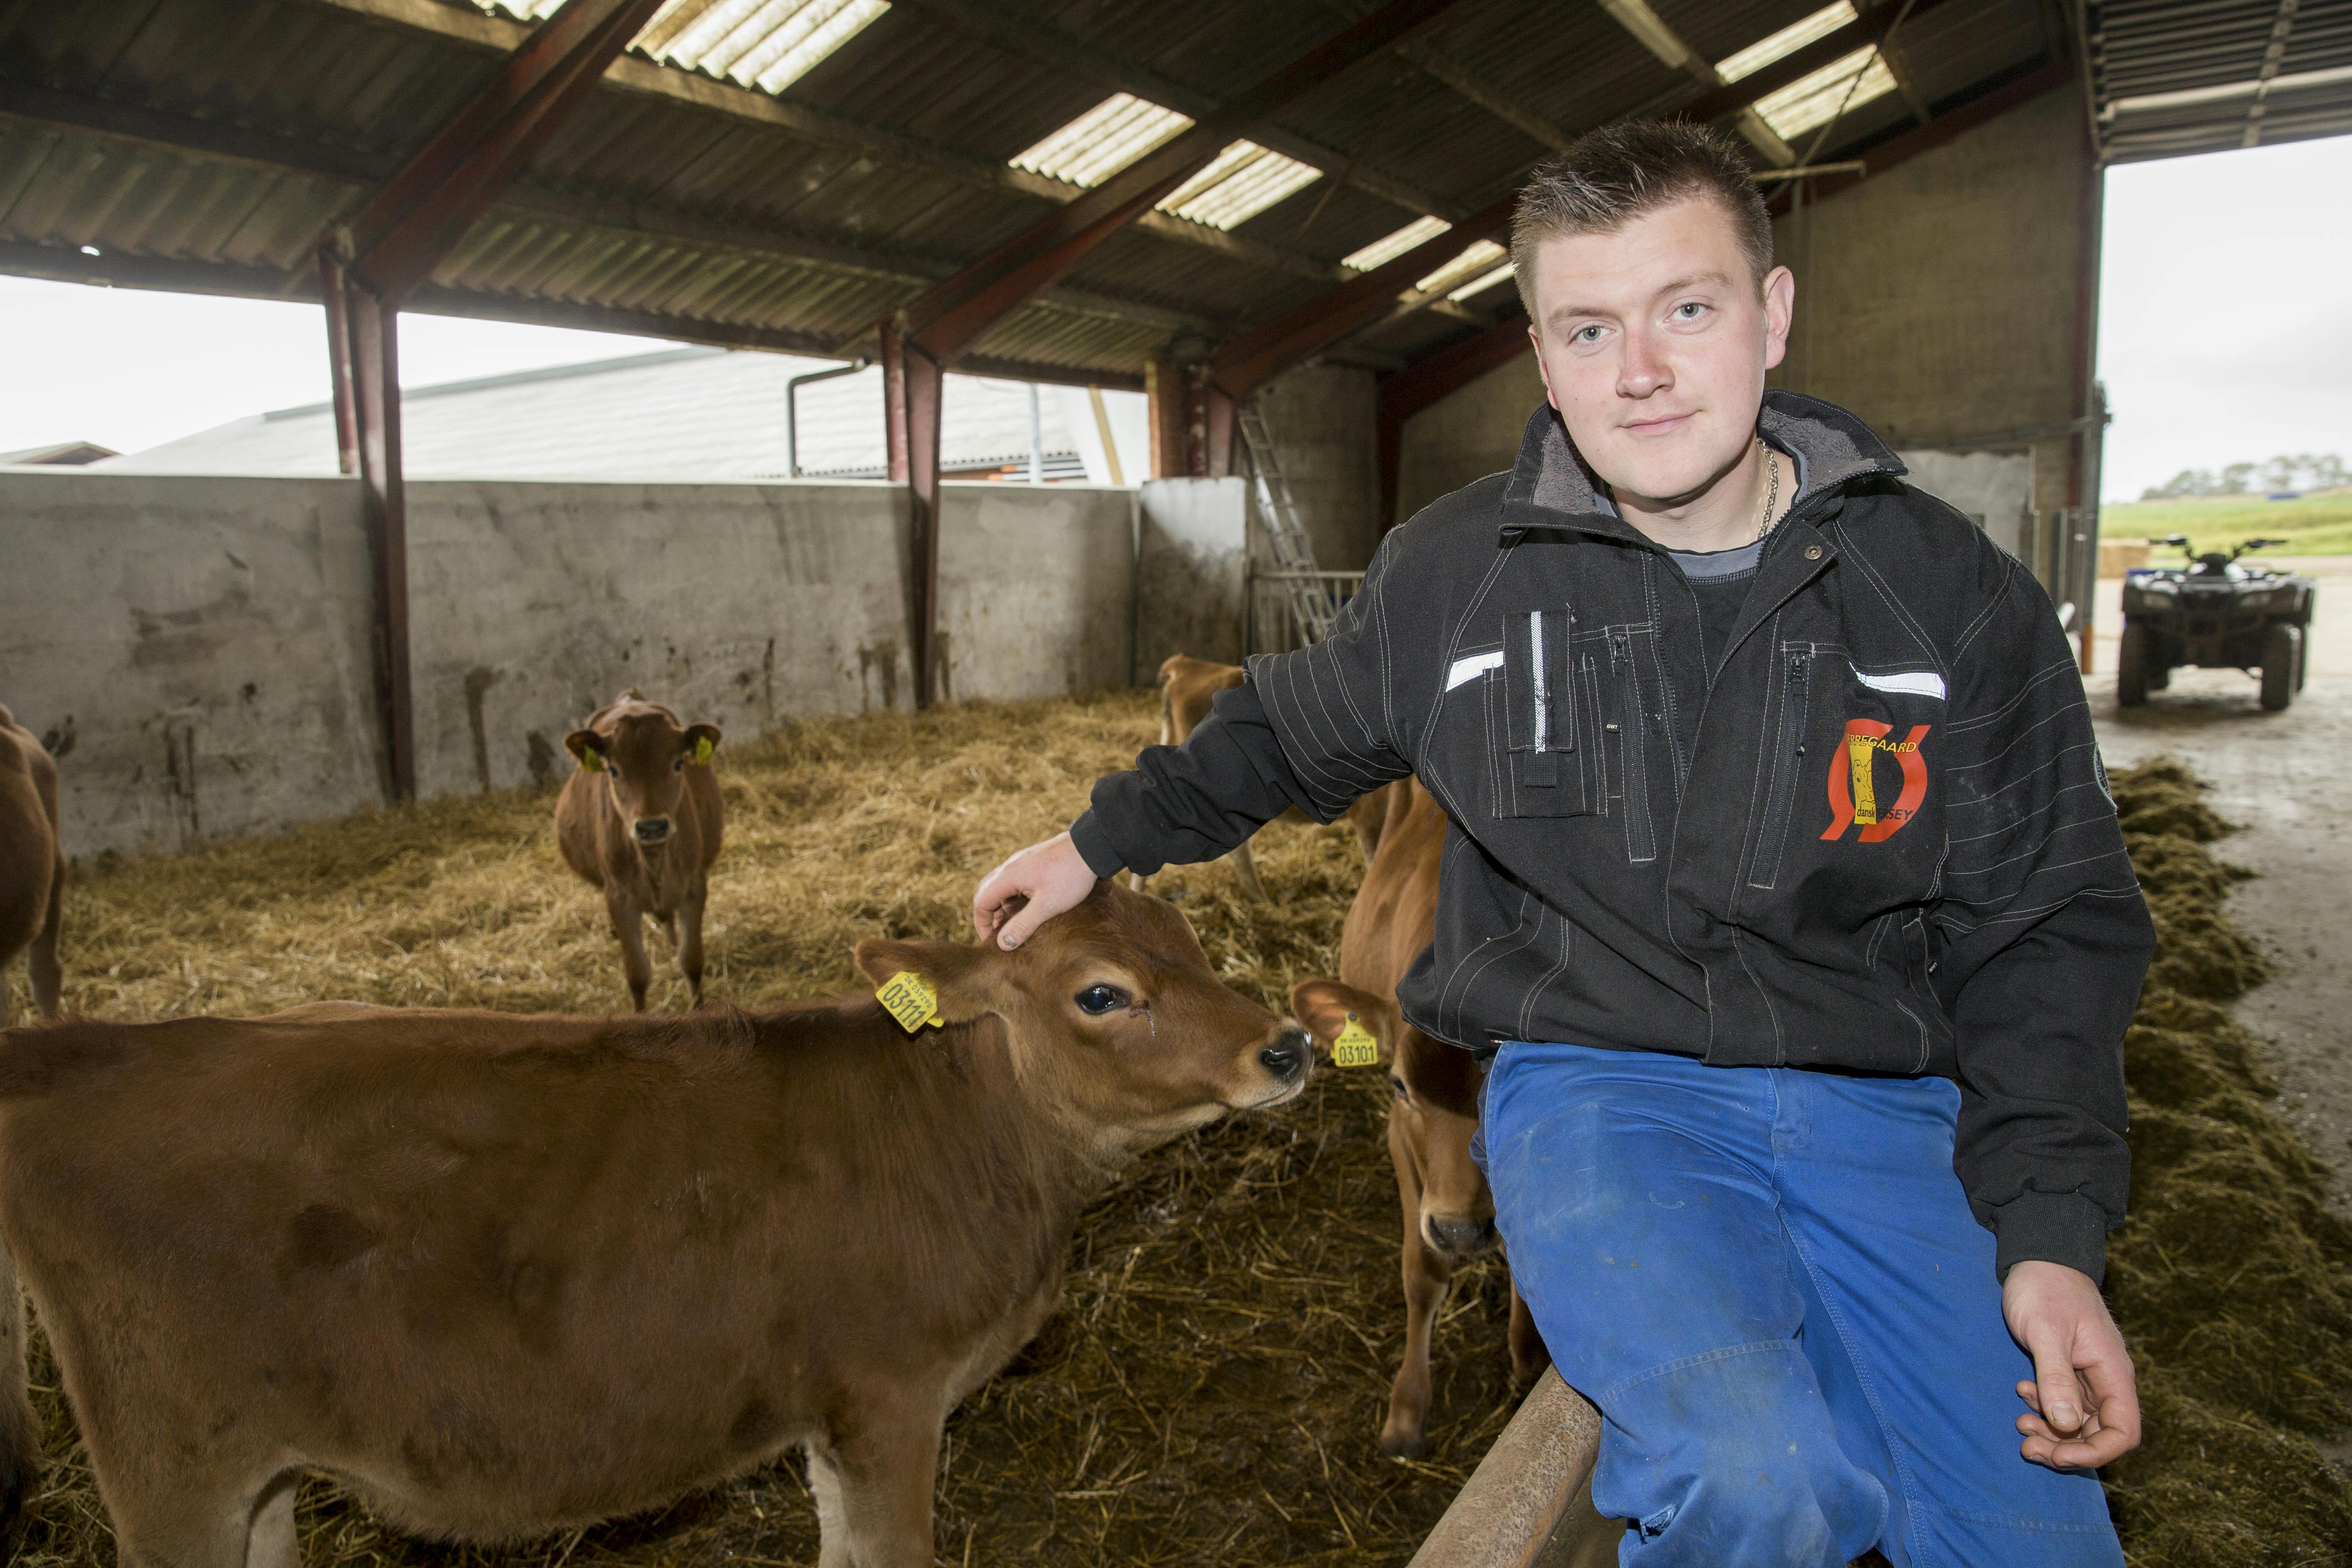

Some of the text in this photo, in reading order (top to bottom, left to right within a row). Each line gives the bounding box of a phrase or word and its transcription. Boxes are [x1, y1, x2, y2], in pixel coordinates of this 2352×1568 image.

[1846, 732, 1917, 753] ERREGAARD
[1857, 806, 1875, 818] dansk
[904, 975, 914, 986] DK
[883, 983, 926, 1028] 03111
[1339, 1045, 1374, 1063] 03101
